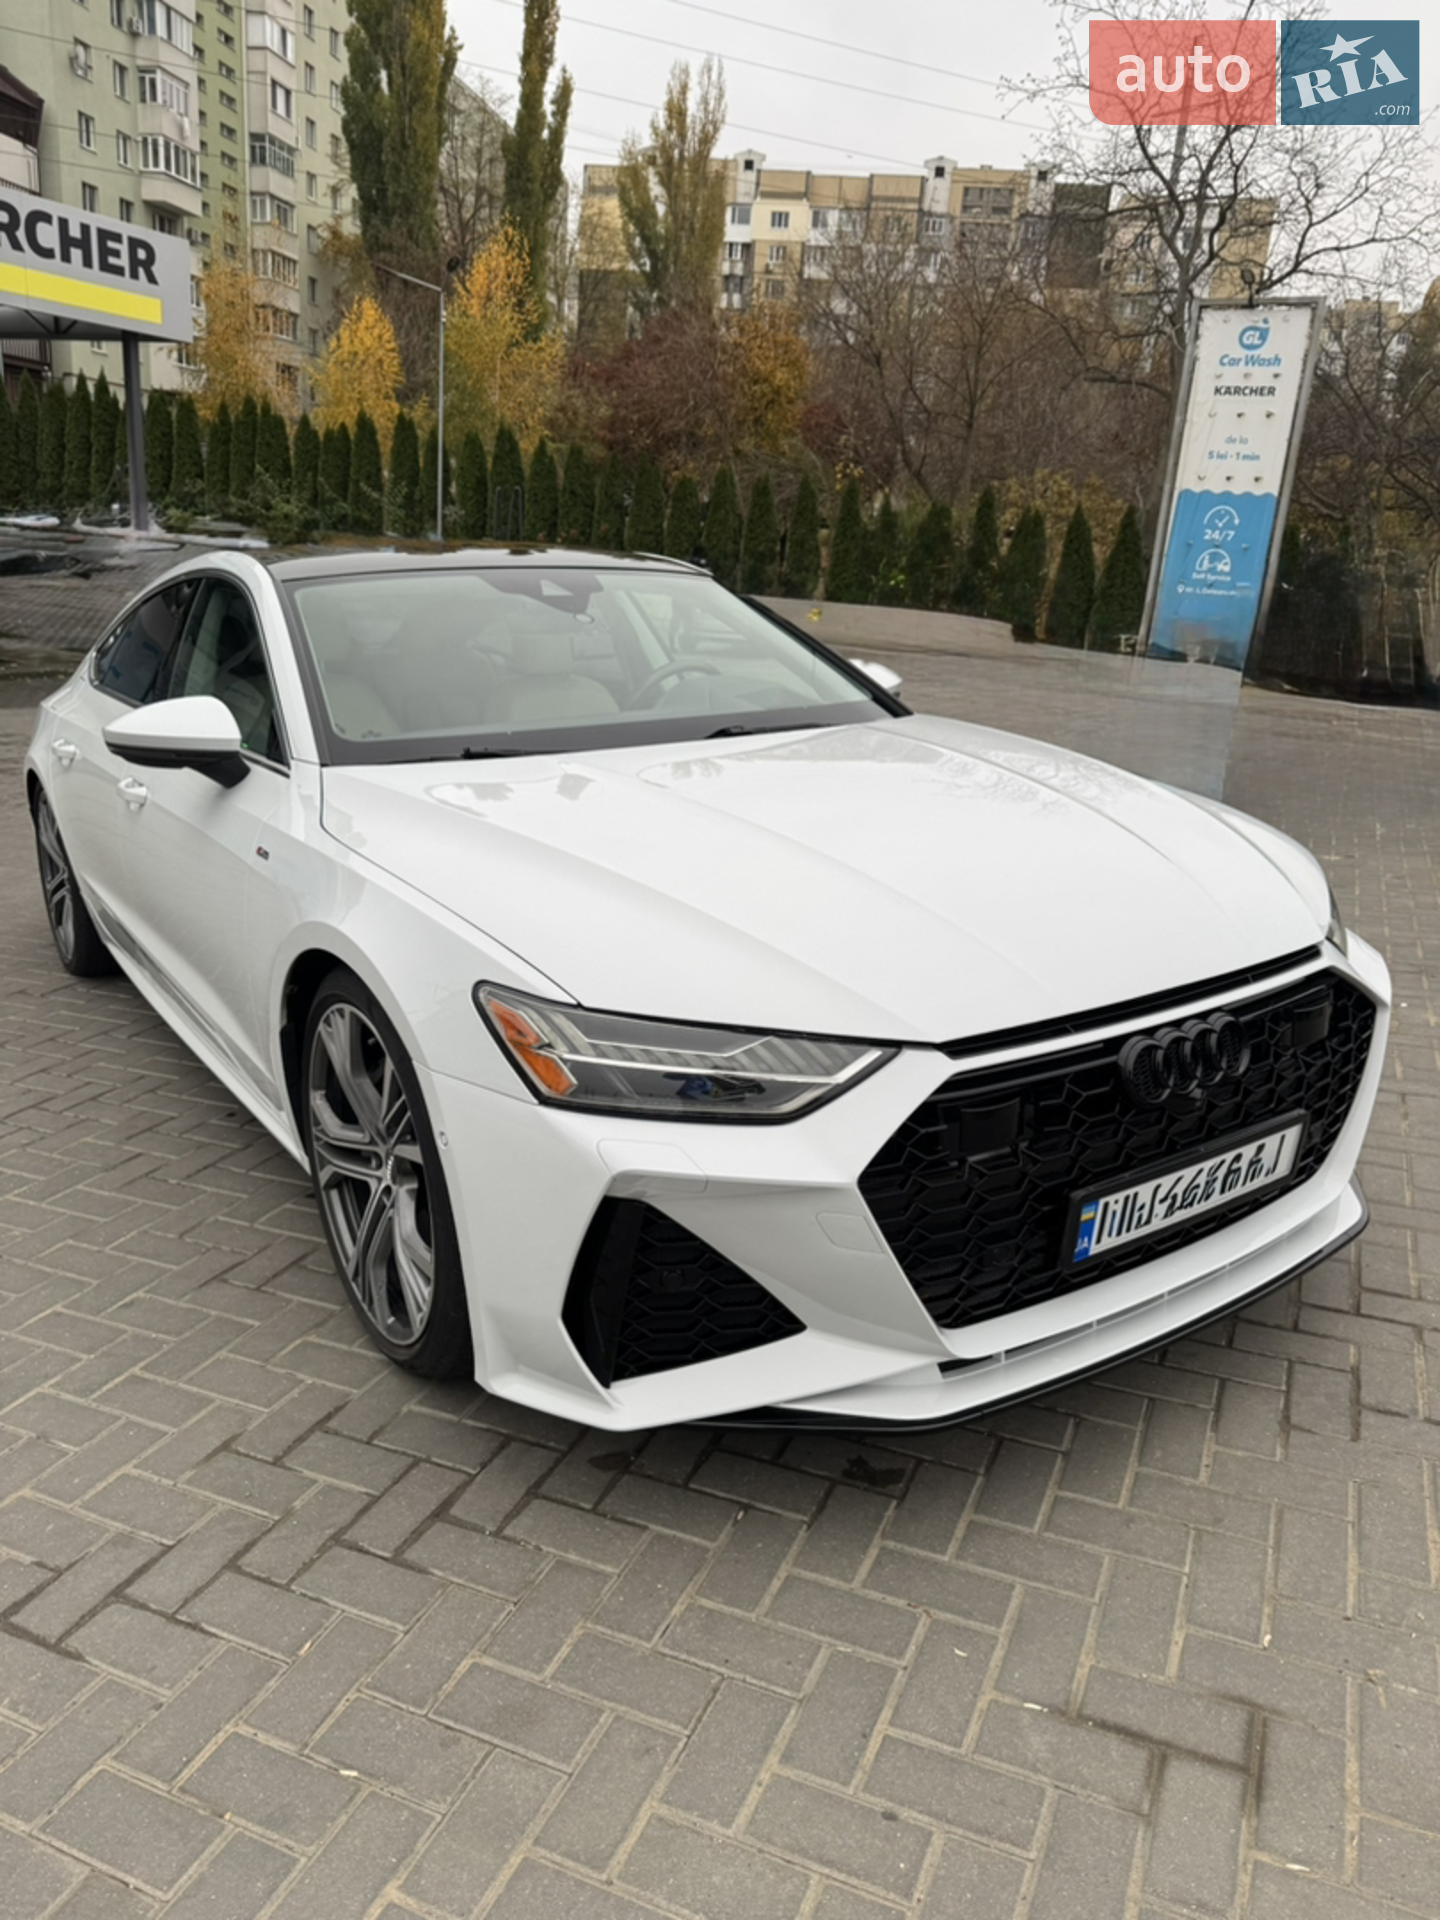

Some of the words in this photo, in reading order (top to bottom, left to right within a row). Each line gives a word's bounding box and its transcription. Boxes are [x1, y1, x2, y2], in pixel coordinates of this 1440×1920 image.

[1219, 354, 1243, 367] Car
[1244, 354, 1282, 367] Wash
[1203, 529, 1236, 541] 24/7
